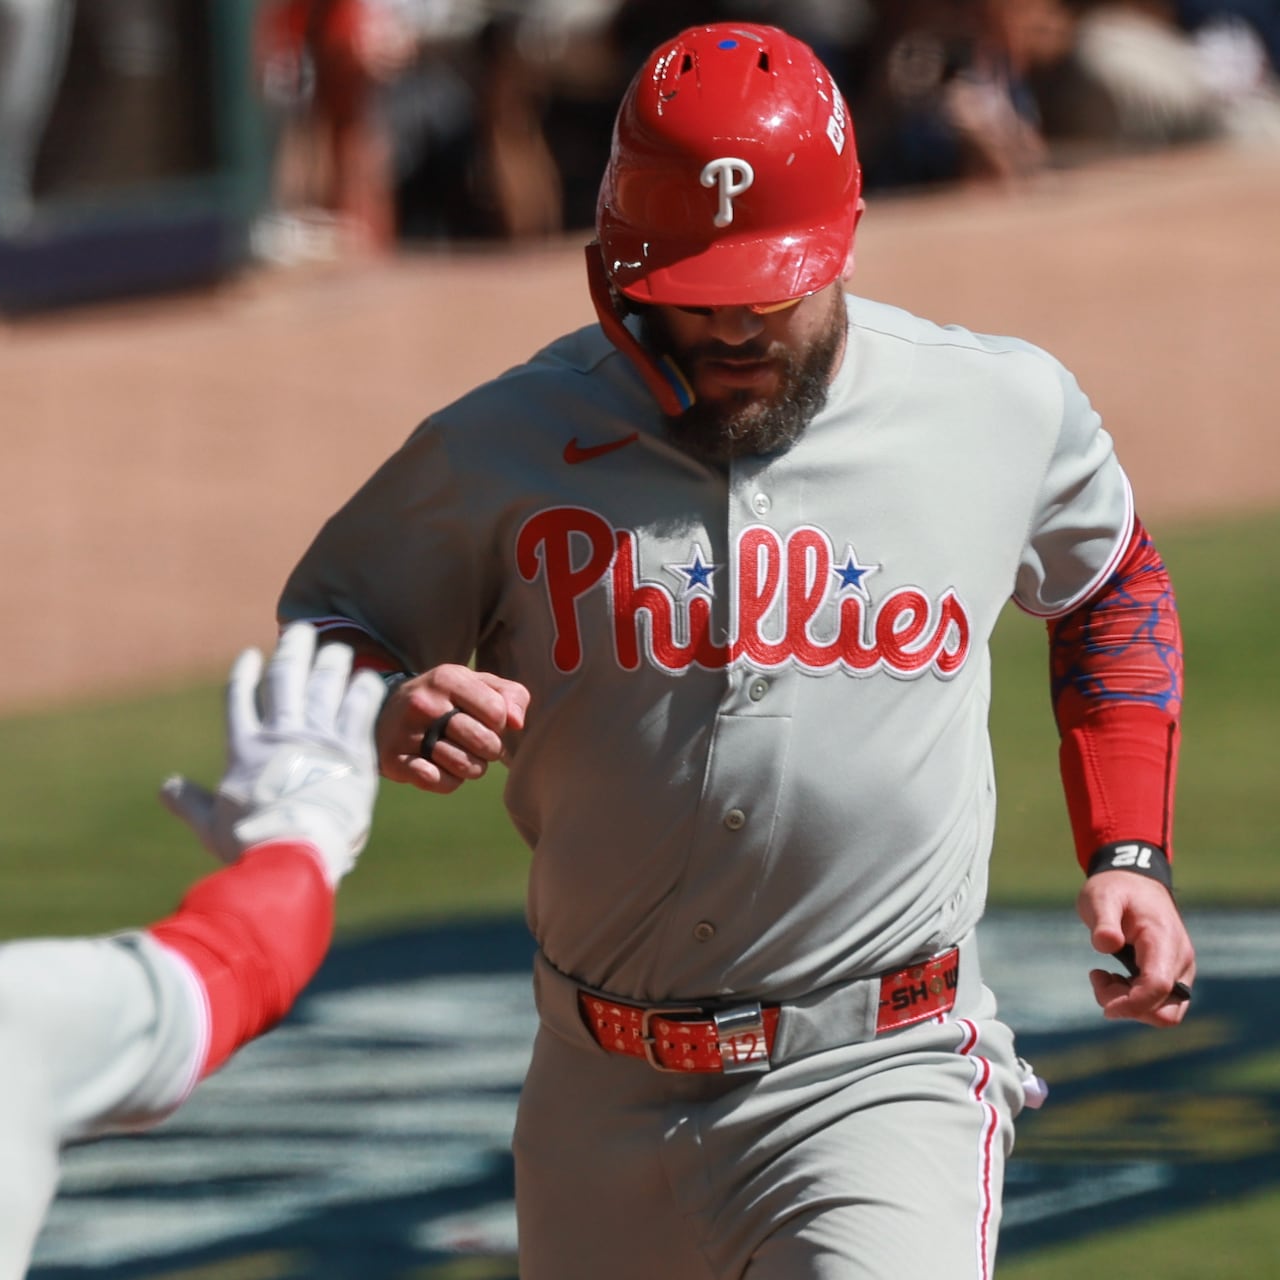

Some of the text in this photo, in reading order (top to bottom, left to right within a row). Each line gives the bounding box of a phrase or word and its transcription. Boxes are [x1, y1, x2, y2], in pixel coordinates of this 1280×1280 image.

[700, 157, 754, 228] P
[516, 505, 972, 682] Phillies
[727, 1033, 761, 1065] 12
